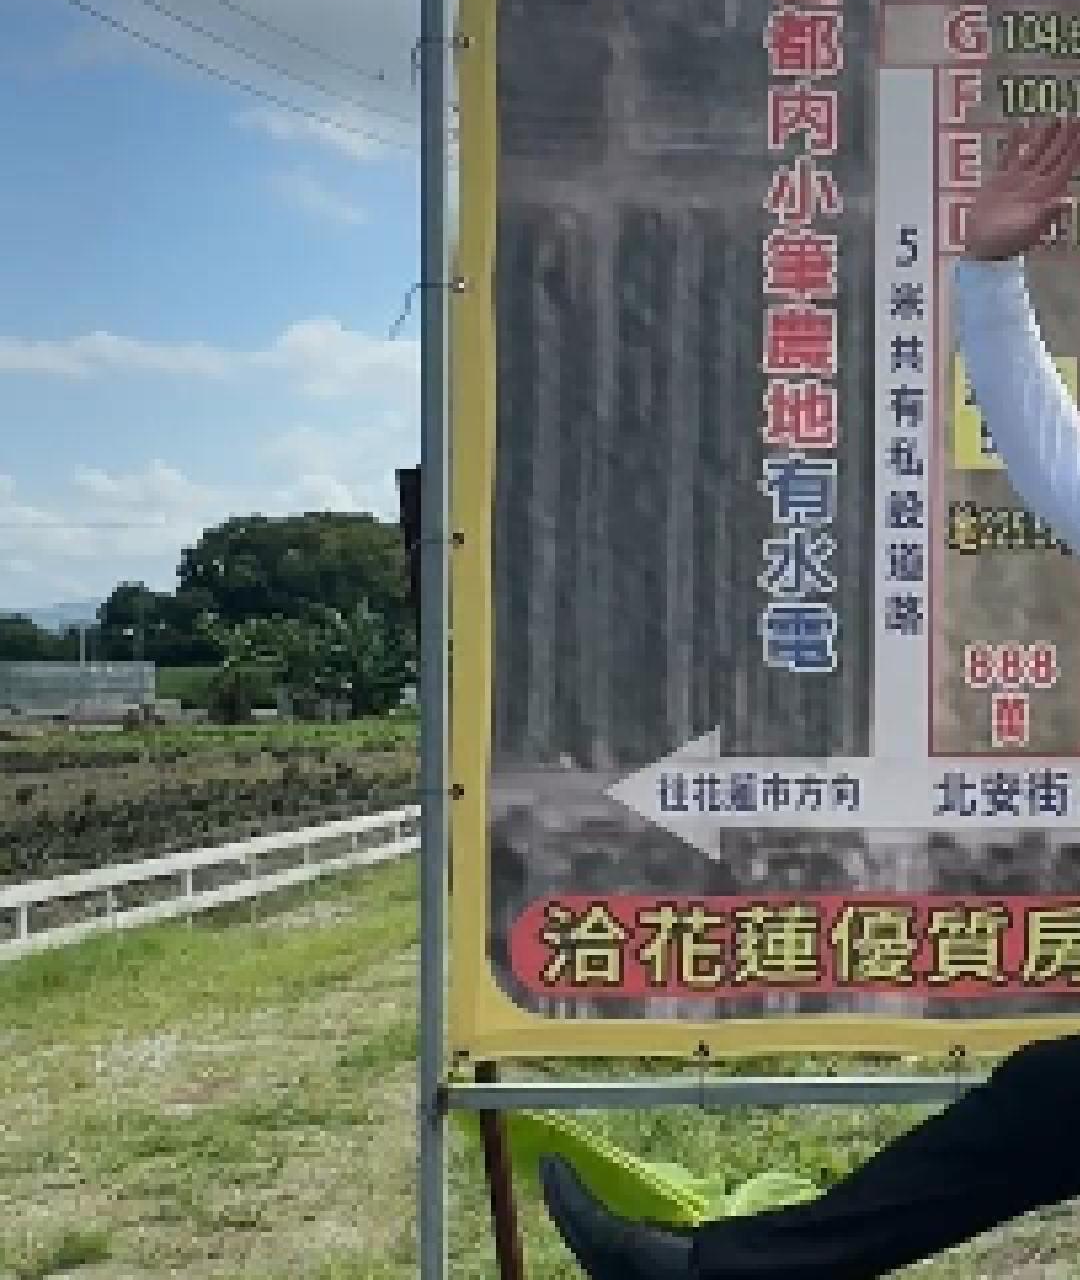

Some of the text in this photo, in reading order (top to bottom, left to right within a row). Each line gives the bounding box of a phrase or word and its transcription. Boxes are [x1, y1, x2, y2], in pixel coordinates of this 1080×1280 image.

[945, 6, 990, 60] G
[947, 69, 982, 124] F
[947, 133, 982, 187] E
[965, 642, 1060, 688] 888
[934, 771, 1069, 817] 北安街
